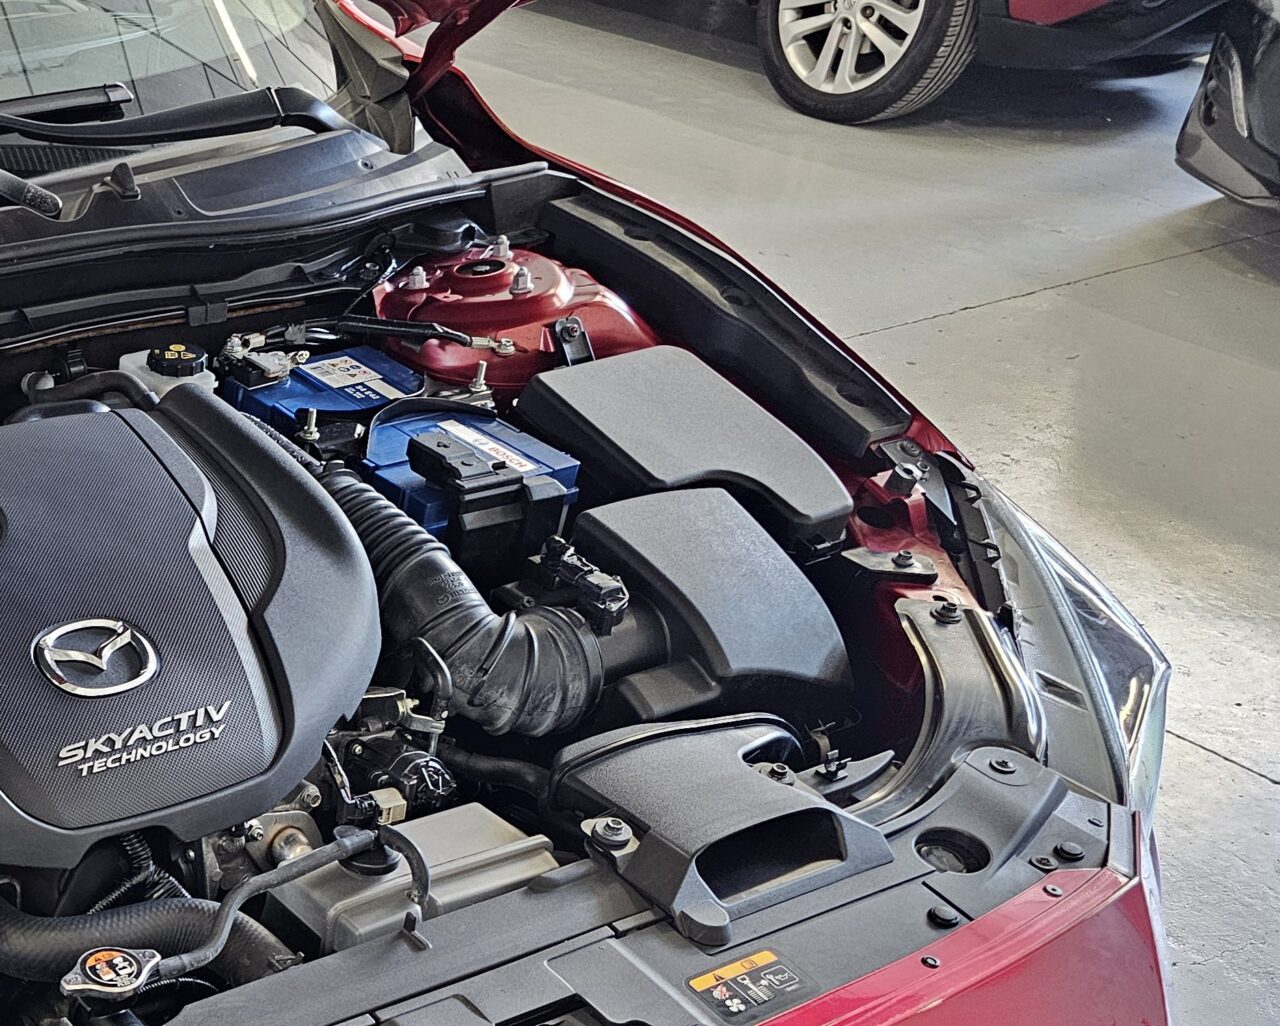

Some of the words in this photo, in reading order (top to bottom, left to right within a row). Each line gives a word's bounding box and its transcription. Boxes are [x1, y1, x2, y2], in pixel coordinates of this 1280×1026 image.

[488, 447, 527, 468] BOSCH
[57, 700, 232, 767] SKYACTIV
[78, 724, 226, 777] TECHNOLOGY
